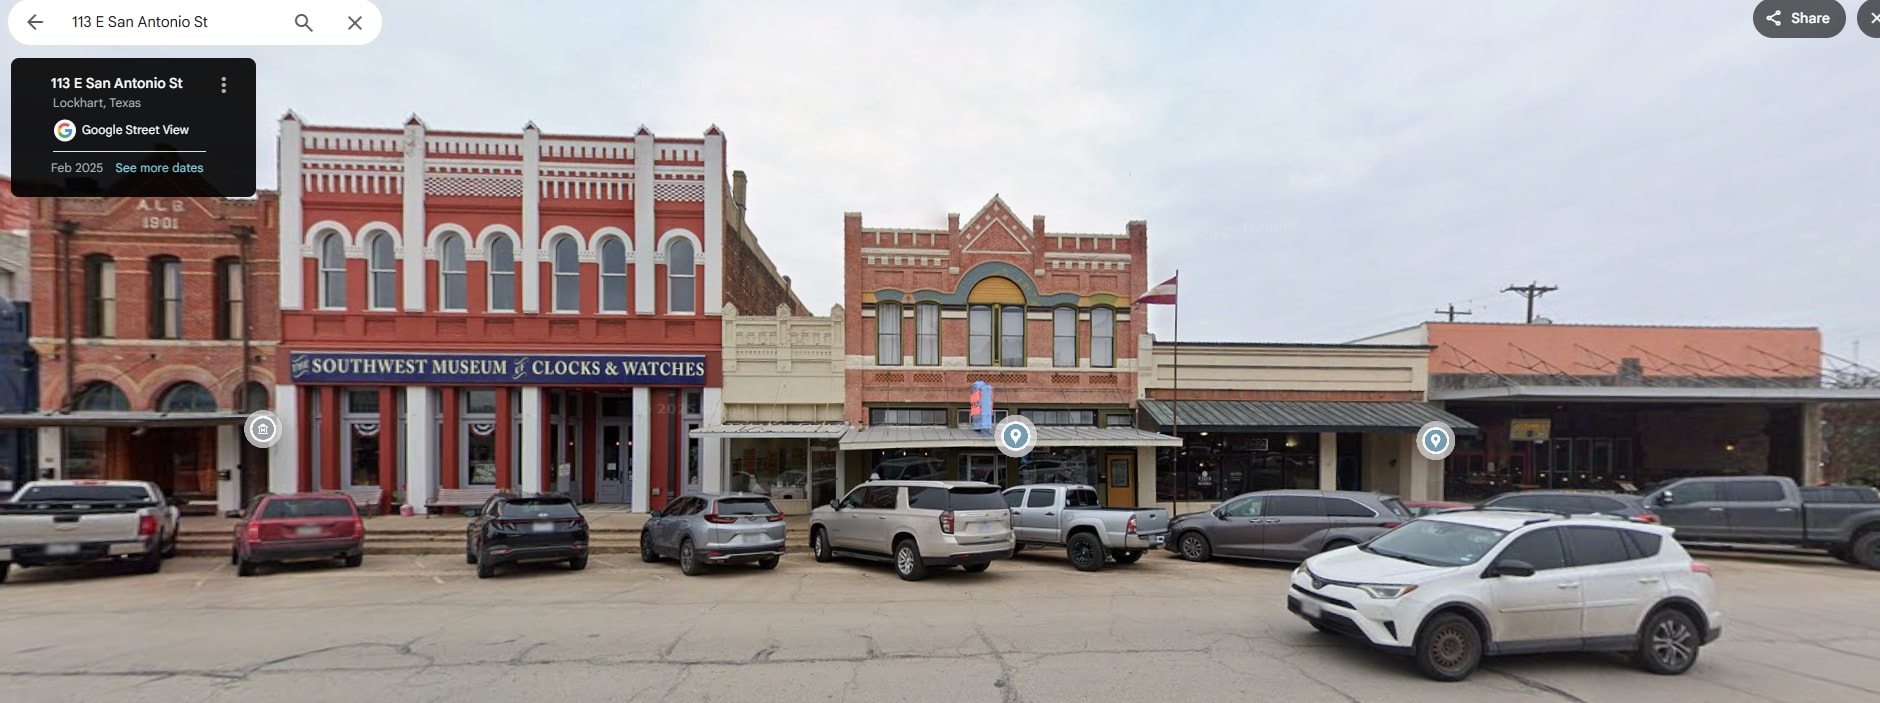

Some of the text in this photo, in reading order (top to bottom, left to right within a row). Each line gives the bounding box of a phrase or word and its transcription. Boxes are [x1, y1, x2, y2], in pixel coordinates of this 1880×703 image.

[142, 216, 179, 229] 1901
[312, 358, 428, 375] SOUTHWEST
[432, 359, 507, 375] MUSEUM
[531, 360, 600, 376] CLOCKS
[604, 361, 619, 376] &
[622, 361, 705, 377] WATCHES
